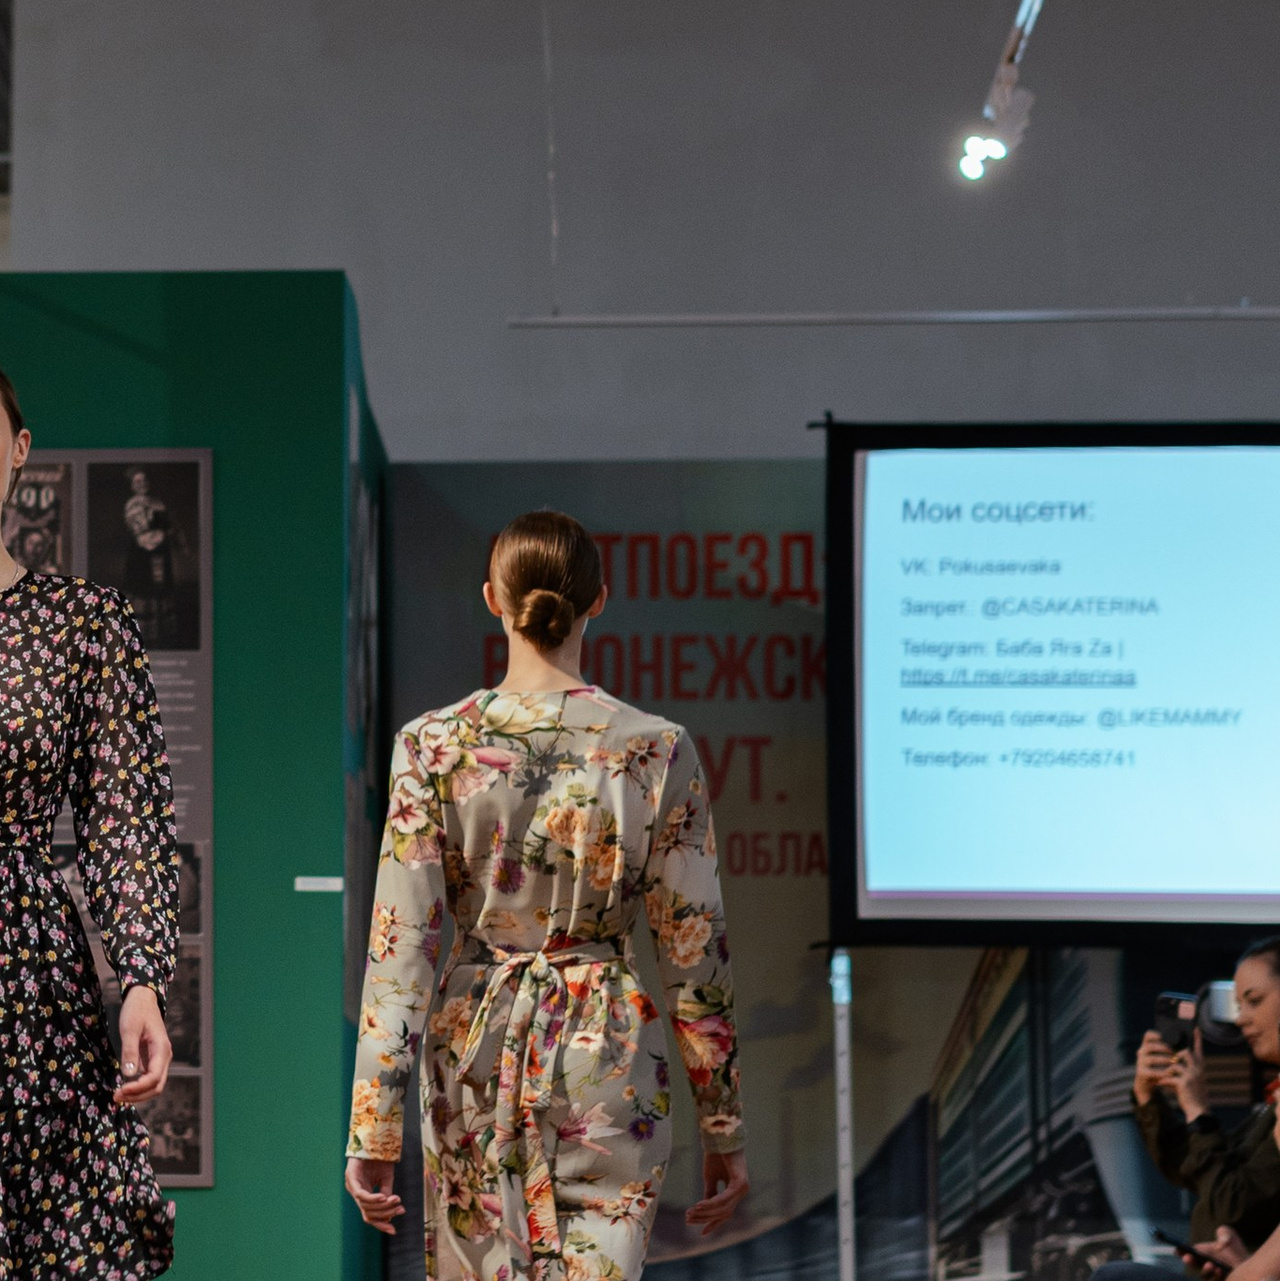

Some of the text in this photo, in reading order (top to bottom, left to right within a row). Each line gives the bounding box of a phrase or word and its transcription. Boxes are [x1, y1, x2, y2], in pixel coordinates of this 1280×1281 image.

[901, 497, 962, 522] Мои
[900, 706, 941, 727] Мой
[946, 705, 1006, 729] бренд
